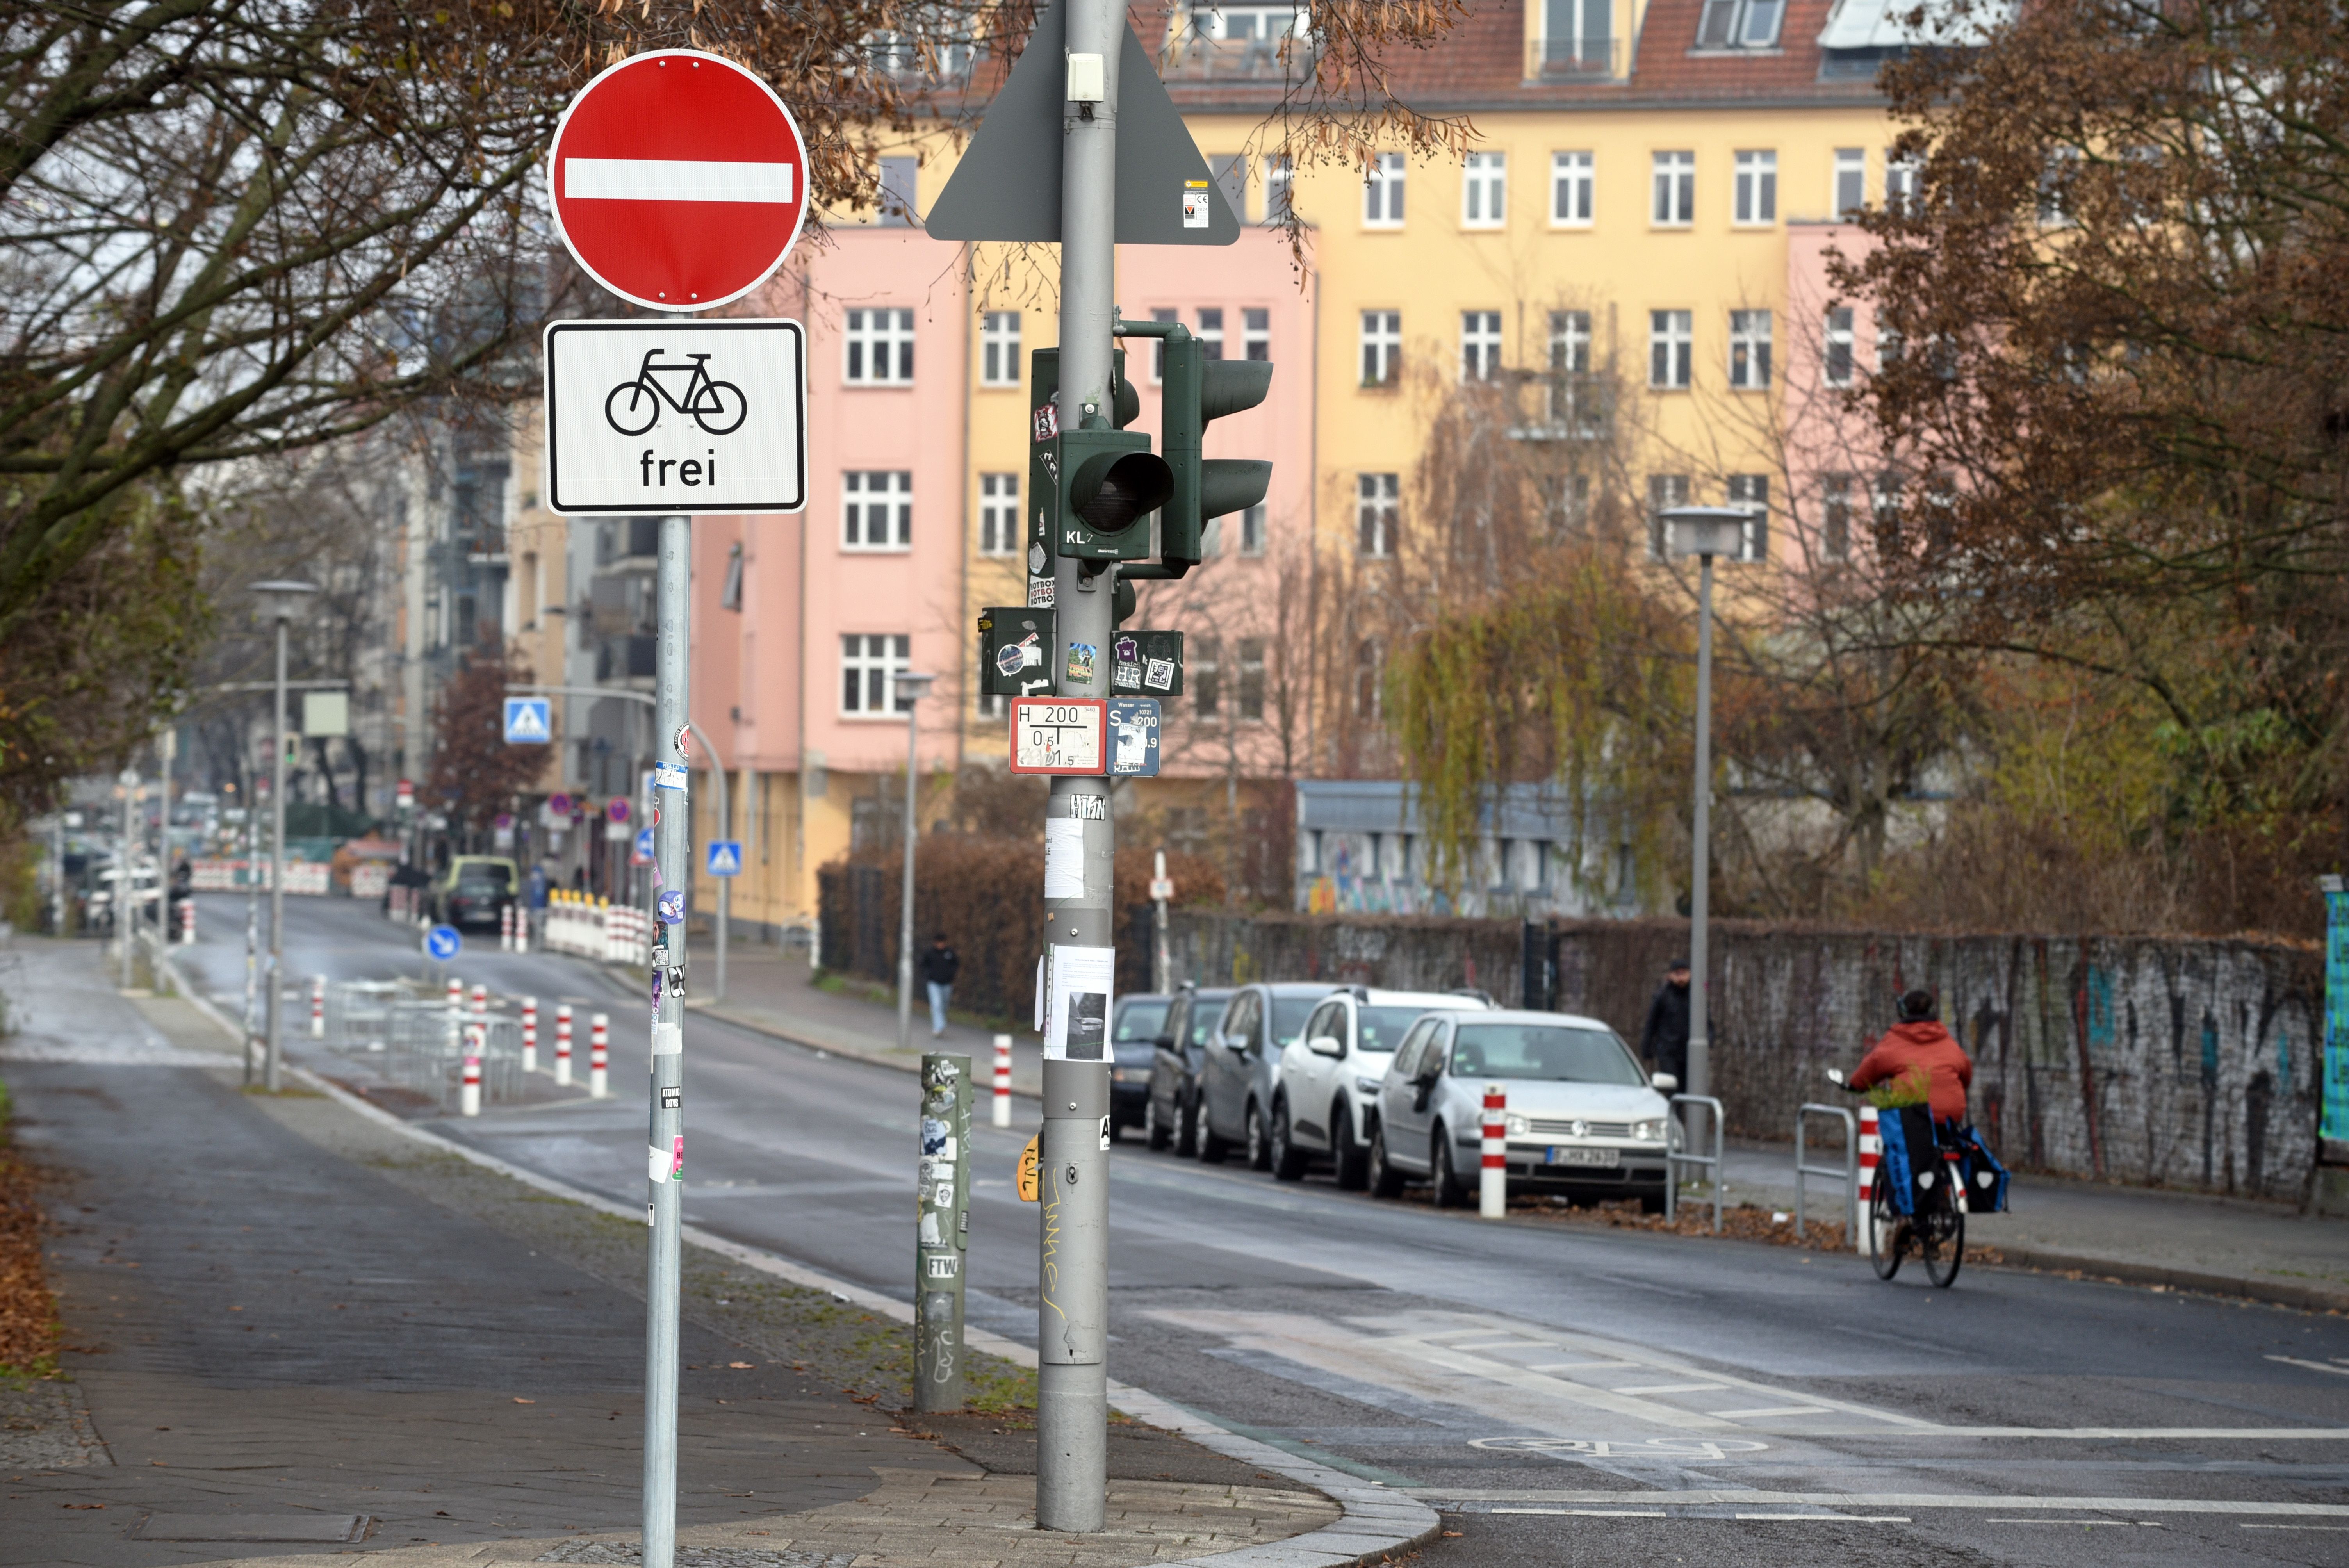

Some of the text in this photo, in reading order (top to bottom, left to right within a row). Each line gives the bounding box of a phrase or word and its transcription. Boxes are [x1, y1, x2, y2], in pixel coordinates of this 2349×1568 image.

[640, 449, 715, 486] frei
[1031, 595, 1054, 606] HOTBO
[1019, 707, 1078, 722] H 200
[1110, 710, 1121, 727] S
[1137, 716, 1157, 727] 200
[665, 1098, 678, 1108] BOYS
[929, 1259, 956, 1274] FTW
